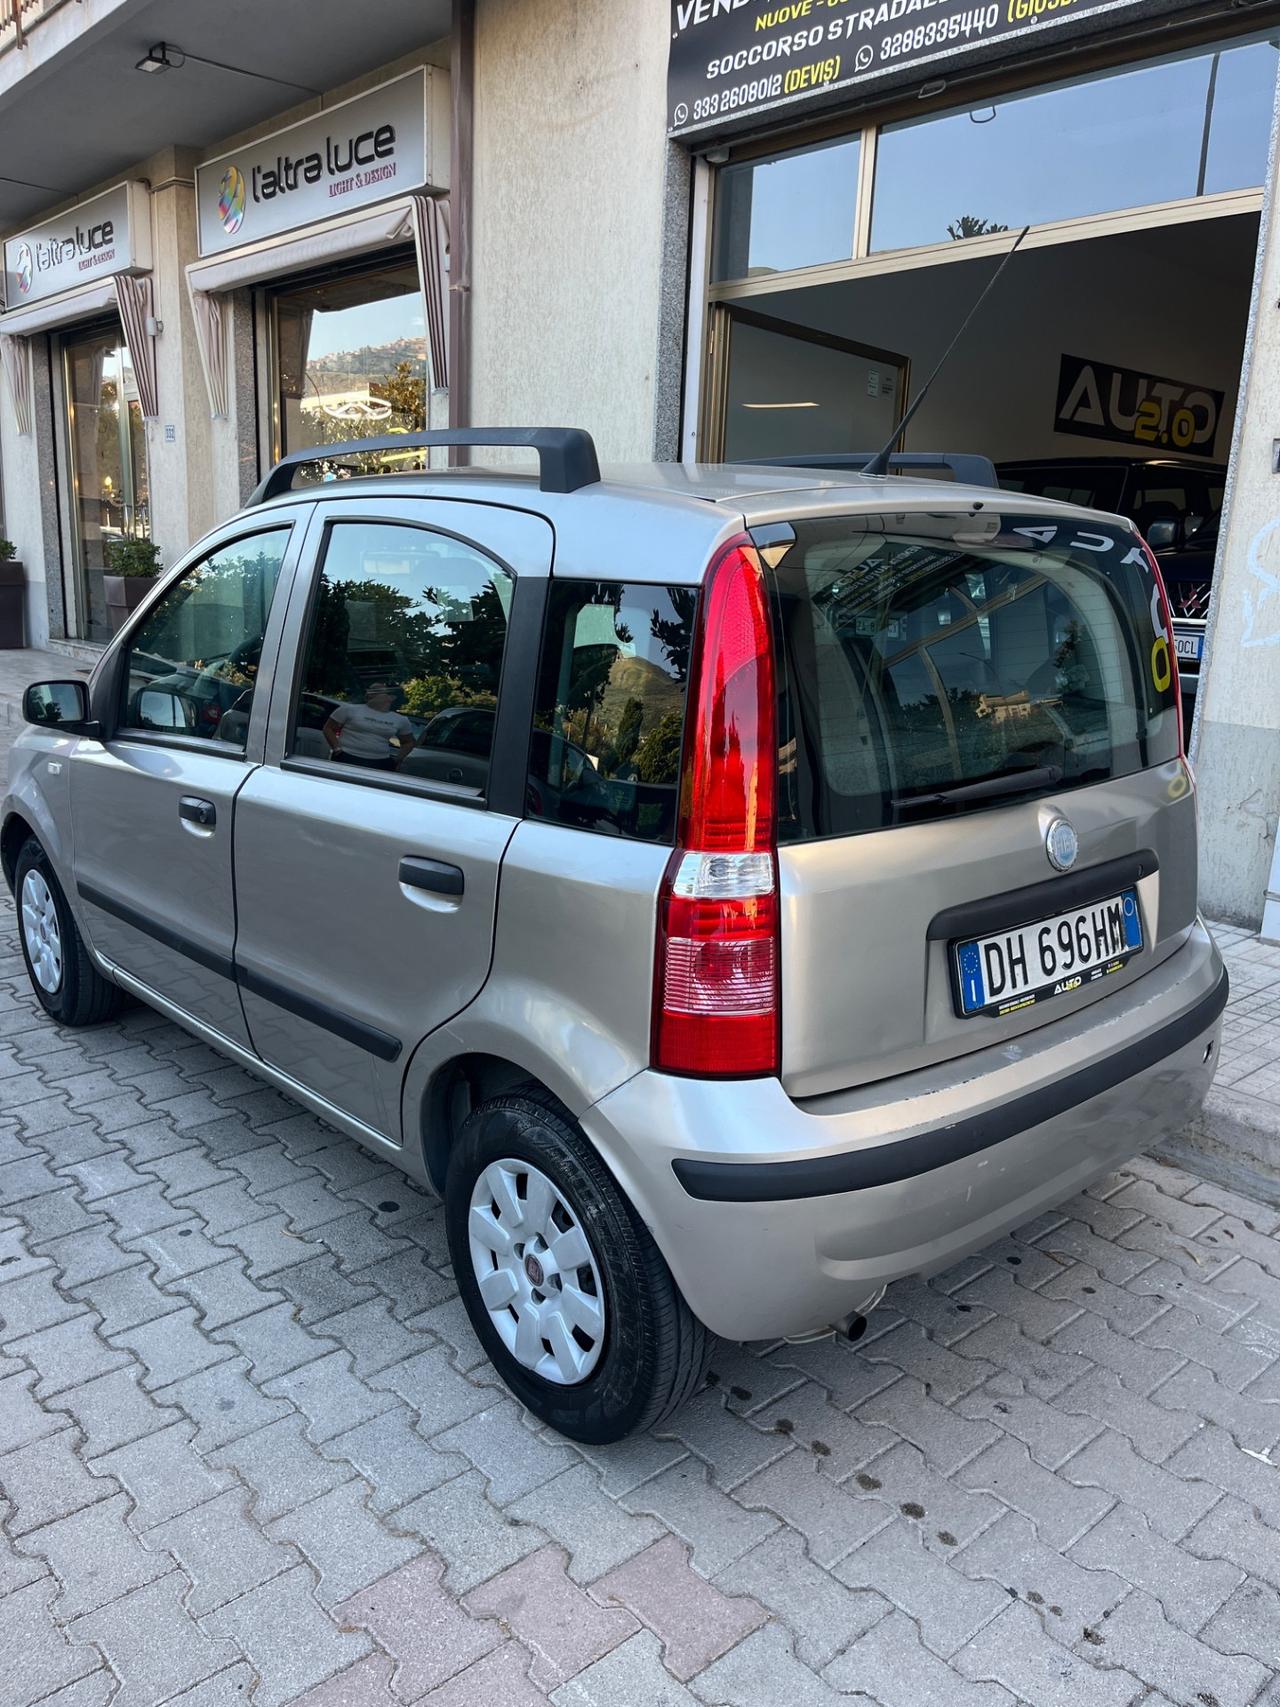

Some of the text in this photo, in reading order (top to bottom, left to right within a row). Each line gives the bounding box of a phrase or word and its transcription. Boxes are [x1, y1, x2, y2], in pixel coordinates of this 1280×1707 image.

[706, 0, 949, 79] SOCCORSO STRADA
[755, 0, 812, 32] NUOVE
[693, 0, 1078, 120] 333 2608012 (DEVIS) 3288335440 (GIU
[326, 124, 396, 176] luce
[328, 162, 397, 198] LIGHT & DESIGN
[76, 220, 114, 256] luce
[1058, 365, 1216, 443] AUTO
[1134, 399, 1195, 447] 2.0
[984, 902, 1125, 997] DH 696HM
